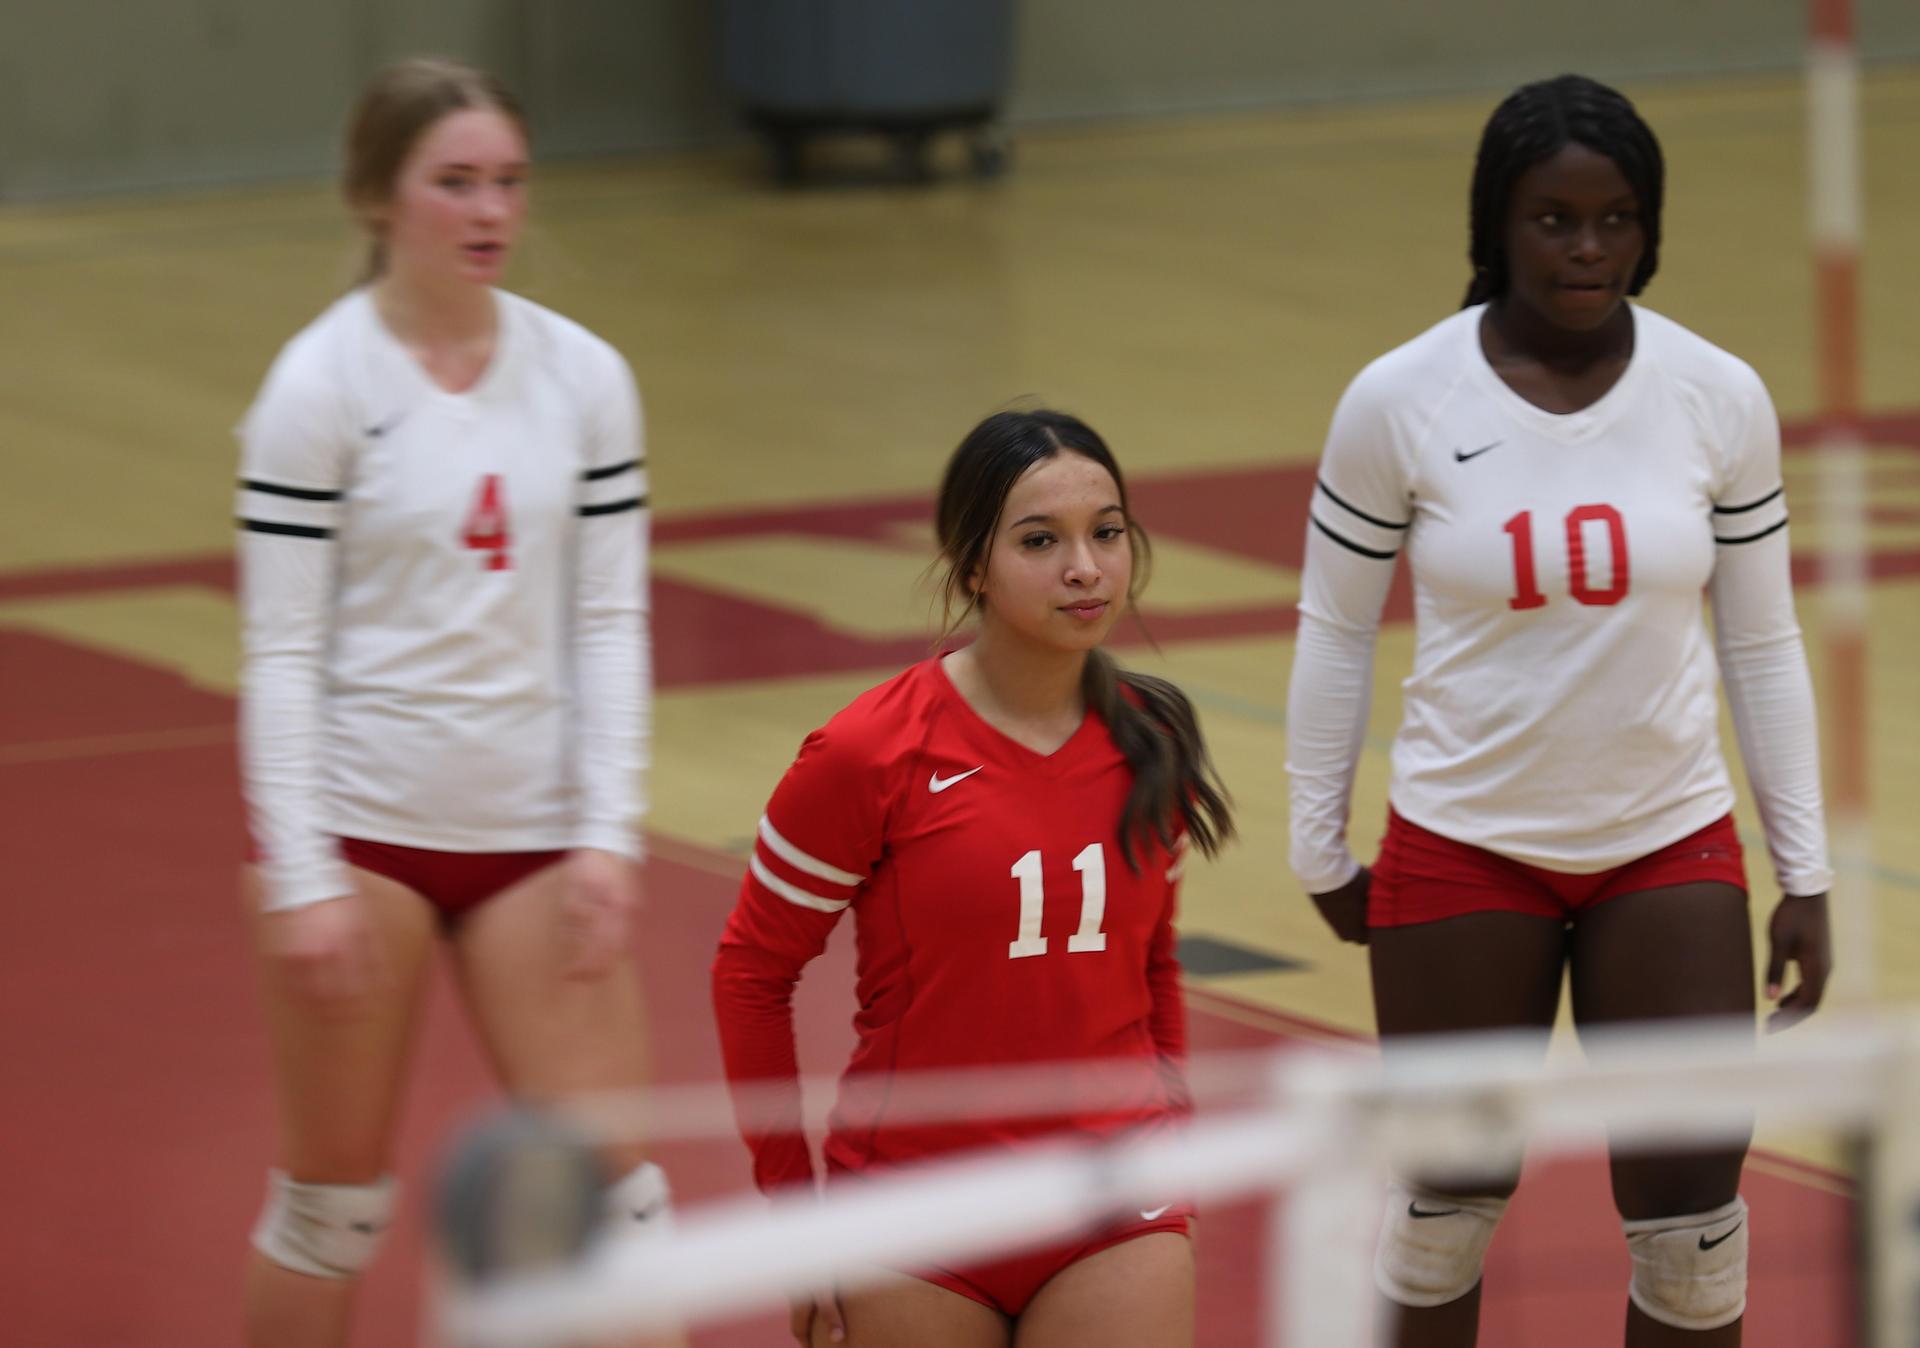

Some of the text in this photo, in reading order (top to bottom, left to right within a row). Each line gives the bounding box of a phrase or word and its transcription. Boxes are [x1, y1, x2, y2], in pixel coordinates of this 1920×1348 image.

[460, 474, 516, 571] 4
[1503, 503, 1630, 611] 10
[1008, 843, 1107, 959] 11
